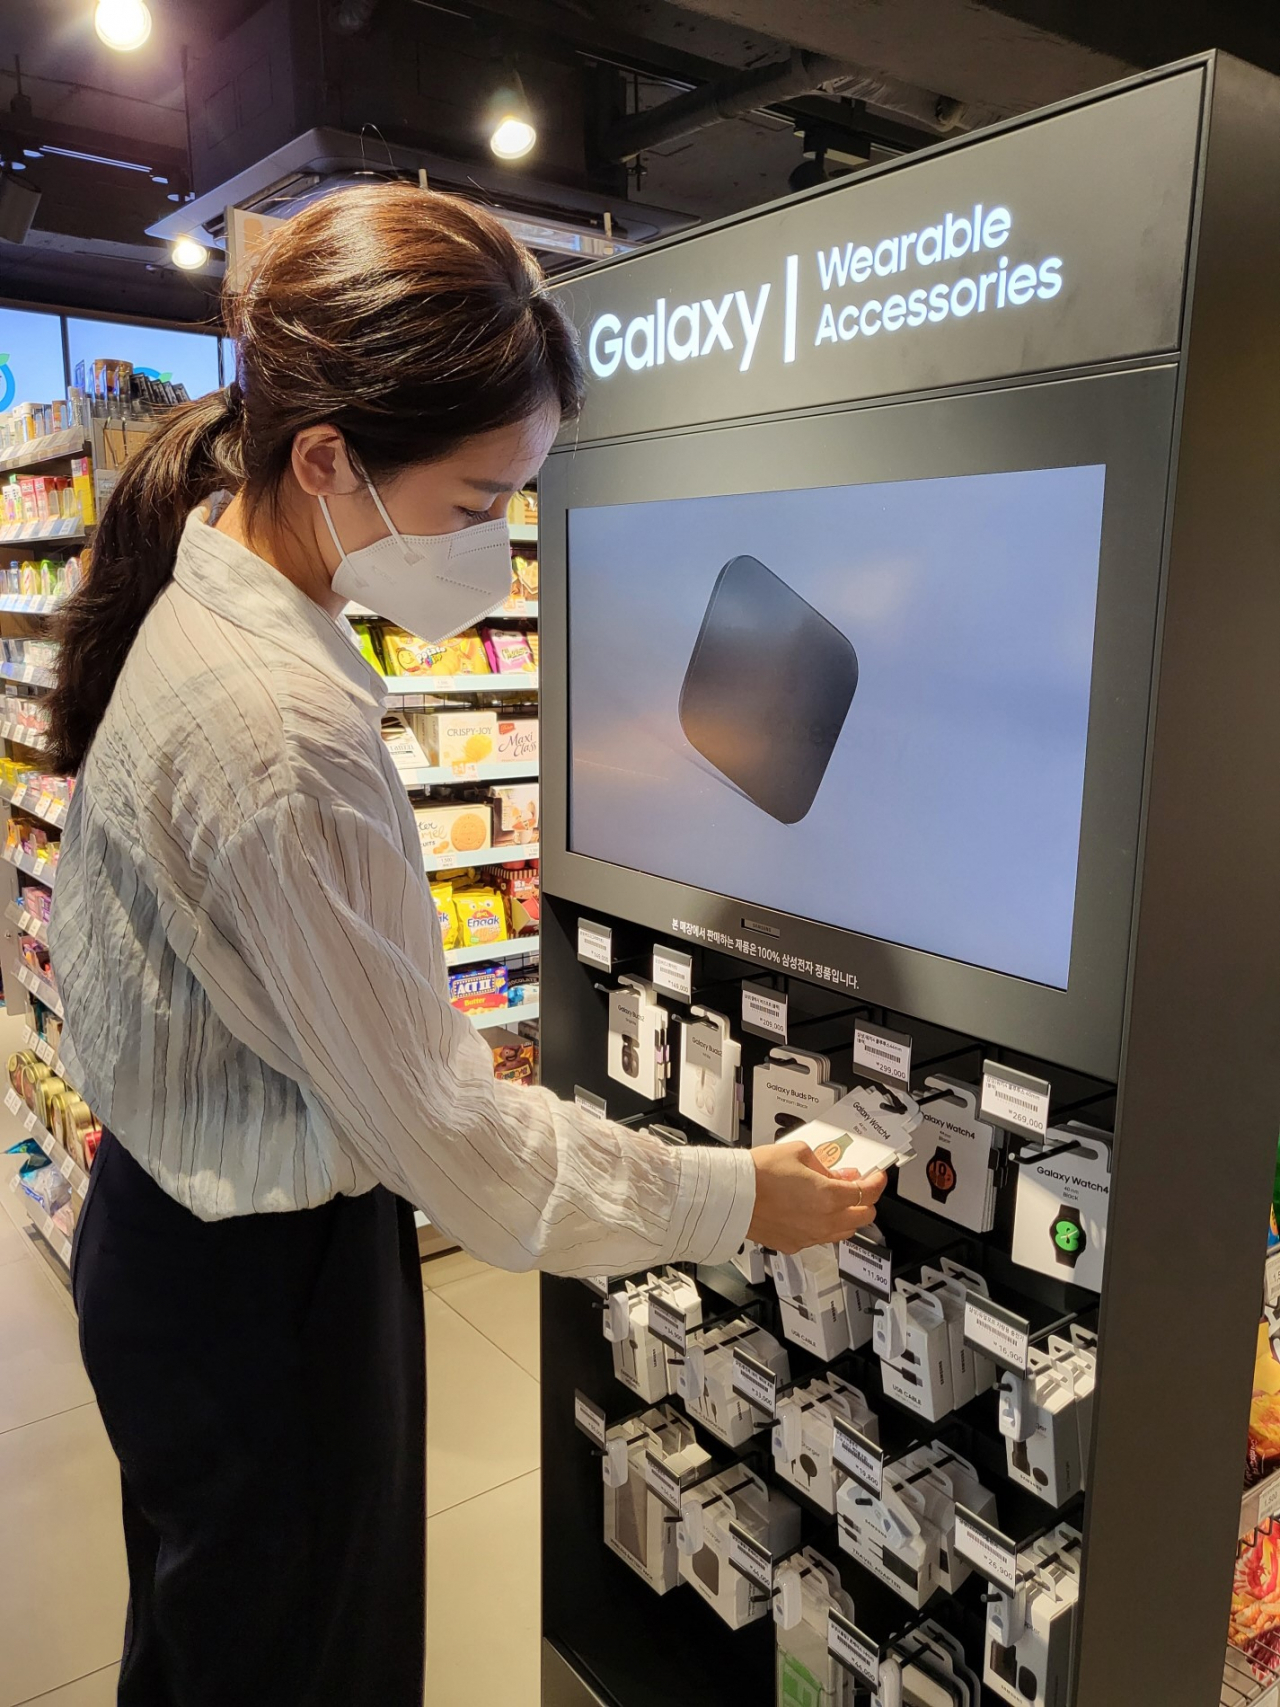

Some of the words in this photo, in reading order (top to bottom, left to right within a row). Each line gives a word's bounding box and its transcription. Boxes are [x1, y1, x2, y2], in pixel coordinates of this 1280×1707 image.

[817, 203, 1012, 291] Wearable
[813, 256, 1064, 347] Accessories
[588, 281, 771, 379] Galaxy
[447, 727, 493, 737] CRISPY-JOY
[468, 916, 500, 927] Enaak
[671, 918, 679, 931] 본
[679, 920, 706, 943] 매장에서
[707, 929, 734, 950] 판매하는
[782, 953, 814, 975] 삼성전자
[814, 962, 860, 990] 정품입니다.
[458, 981, 478, 995] ACT
[464, 998, 486, 1007] Butter
[766, 1082, 791, 1096] Galaxy
[790, 1090, 807, 1101] Buds
[807, 1094, 820, 1104] Pro
[852, 1101, 871, 1121] Galaxy
[869, 1118, 891, 1140] Watch4
[921, 1111, 945, 1128] alaxy
[946, 1121, 975, 1139] Watch4
[1037, 1166, 1070, 1184] Galaxy
[1072, 1176, 1109, 1194] Watch4
[1063, 1192, 1079, 1201] Black
